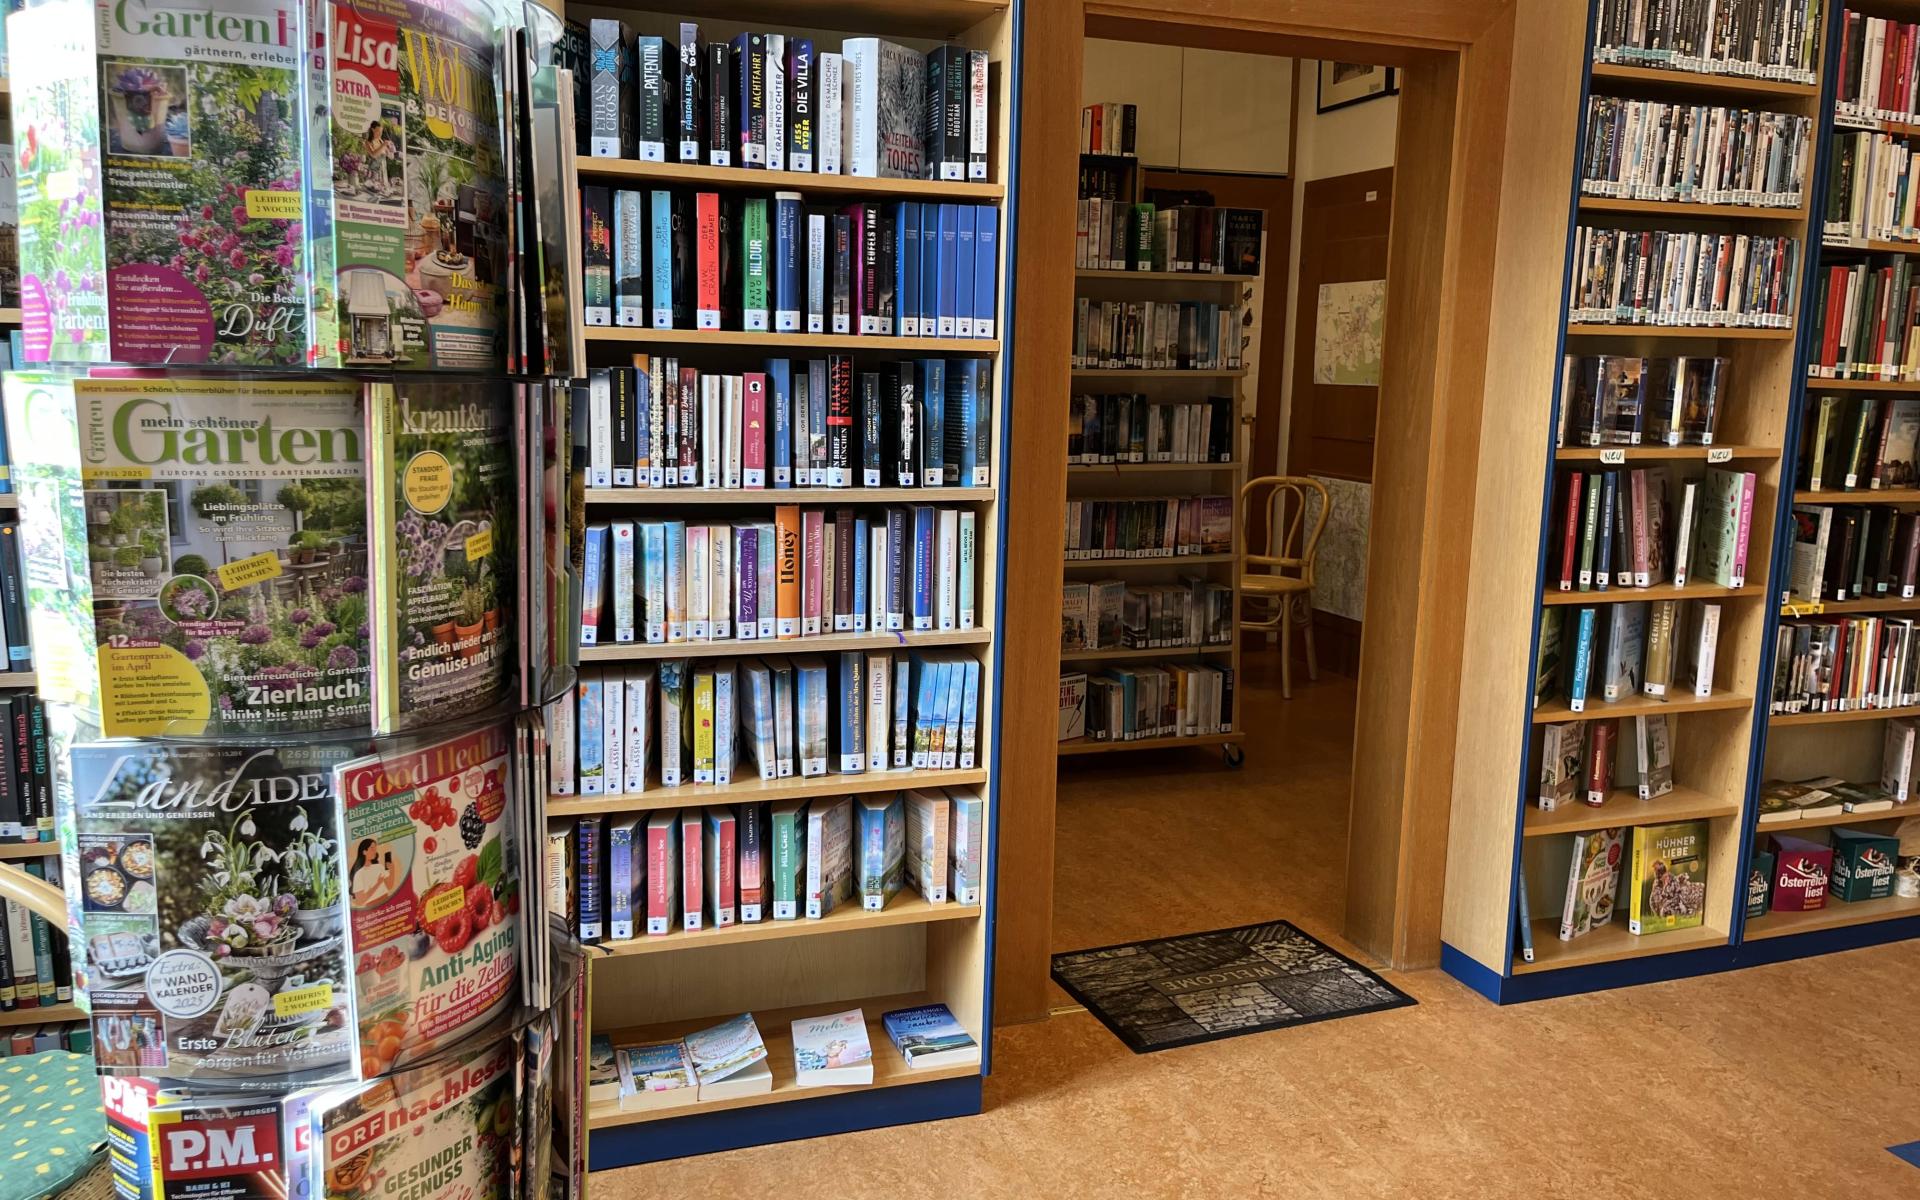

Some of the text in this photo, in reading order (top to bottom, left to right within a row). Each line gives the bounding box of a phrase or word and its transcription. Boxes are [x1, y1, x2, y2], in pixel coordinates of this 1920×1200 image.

[184, 45, 247, 60] gärtnern,
[336, 21, 398, 71] Lisa
[680, 44, 689, 65] APP
[688, 42, 696, 57] die
[595, 48, 605, 71] RACHE
[643, 44, 660, 90] PATIENTIN
[752, 52, 762, 109] NACHTFAHRT
[954, 56, 962, 88] SCHATTEN
[336, 78, 371, 98] EXTRA
[797, 53, 808, 114] DIE VILLA
[975, 58, 984, 109] TRÄNENGRAB
[406, 100, 420, 114] &
[594, 84, 606, 131] ETHAN
[605, 85, 617, 131] CROSS
[685, 74, 693, 131] FABIAN LENK
[794, 123, 802, 145] JESS
[802, 119, 810, 150] RYDER
[886, 147, 921, 175] TODES
[108, 169, 173, 181] Pflegeleichte
[108, 179, 188, 190] Trockenkünstler
[111, 220, 177, 231] Akku-Antrieb
[173, 213, 190, 222] mit
[629, 204, 637, 267] KAISERWALD
[866, 208, 876, 266] TEUFELS TANZ
[749, 238, 762, 276] HILDUR
[115, 274, 160, 283] Entdecken
[1636, 273, 1645, 298] CIRCLE
[251, 293, 270, 303] Die
[175, 386, 236, 394] Sommerblüher
[238, 387, 250, 395] für
[252, 387, 275, 395] Beete
[295, 389, 322, 397] eigene
[841, 360, 850, 414] NESSER
[112, 398, 363, 466] Garten
[141, 416, 259, 429] mein schöner
[681, 408, 689, 437] HAUSBOOT
[840, 427, 848, 467] MÜNCHEN
[1604, 452, 1622, 461] NEU
[1711, 451, 1729, 460] NEU
[160, 469, 208, 477] EUROPAS
[213, 469, 267, 477] GRÖSSTES
[272, 468, 360, 477] GARTENMAGAZIN
[203, 501, 285, 513] Lieblingsplätze
[212, 512, 277, 524] im Frühling:
[212, 524, 232, 533] wird
[235, 533, 279, 544] Blickfang
[224, 557, 270, 576] LEIHFRIST
[780, 529, 798, 584] Honey
[235, 566, 274, 583] WOCHEN
[408, 582, 452, 595] FASZINATION
[408, 593, 449, 605] APFELBAUM
[178, 620, 246, 629] Trendiger Thymian
[197, 628, 240, 637] Beet Topf
[1651, 612, 1660, 644] GENIES
[108, 635, 159, 647] 12 Seiten
[408, 634, 481, 661] Endlich wieder
[111, 652, 173, 663] Gartenpraxis
[125, 661, 152, 673] April
[408, 649, 490, 681] Gemüse und
[1575, 639, 1588, 682] Fischerprüfung
[223, 668, 325, 682] Bienenfreundlicher
[247, 679, 361, 705] Zierlauch
[873, 672, 883, 706] Haribo
[222, 706, 323, 722] blüht bis zum
[17, 713, 29, 773] Bestie Mensch
[32, 705, 46, 775] Gierige Bestie
[287, 750, 349, 759] 269 IDEEN
[611, 741, 619, 770] LASSEN
[351, 754, 428, 801] Good
[81, 811, 215, 819] LAND ERLEBEN UND GENIESSEN
[348, 792, 415, 820] Blitz-Übungen
[351, 816, 406, 837] Schmerzen
[366, 808, 394, 826] gegen
[1656, 835, 1696, 849] HÜHNER
[1662, 847, 1689, 859] LIEBE
[550, 852, 561, 889] Savannah
[657, 861, 665, 895] Schwestern
[1779, 873, 1828, 888] Österreich
[1854, 863, 1895, 880] Österreich
[1872, 875, 1890, 887] liest
[1804, 886, 1824, 898] liest
[419, 924, 515, 992] Anti-Aging
[163, 972, 213, 987] WAND-
[1160, 963, 1279, 991] WELCOME
[156, 983, 214, 998] KALENDER
[282, 989, 327, 1003] LEIHFRIST
[411, 952, 514, 1026] für die Zellen
[172, 996, 204, 1009] 2025
[290, 997, 328, 1010] WOCHEN
[178, 1018, 302, 1050] Erste Blüten
[197, 1052, 279, 1071] sorgen für
[243, 1106, 277, 1117] MORGEN
[334, 1057, 507, 1153] ORF nachlese
[167, 1125, 273, 1171] P.M.
[384, 1133, 472, 1194] GESUNDER
[399, 1159, 463, 1200] GENUSS
